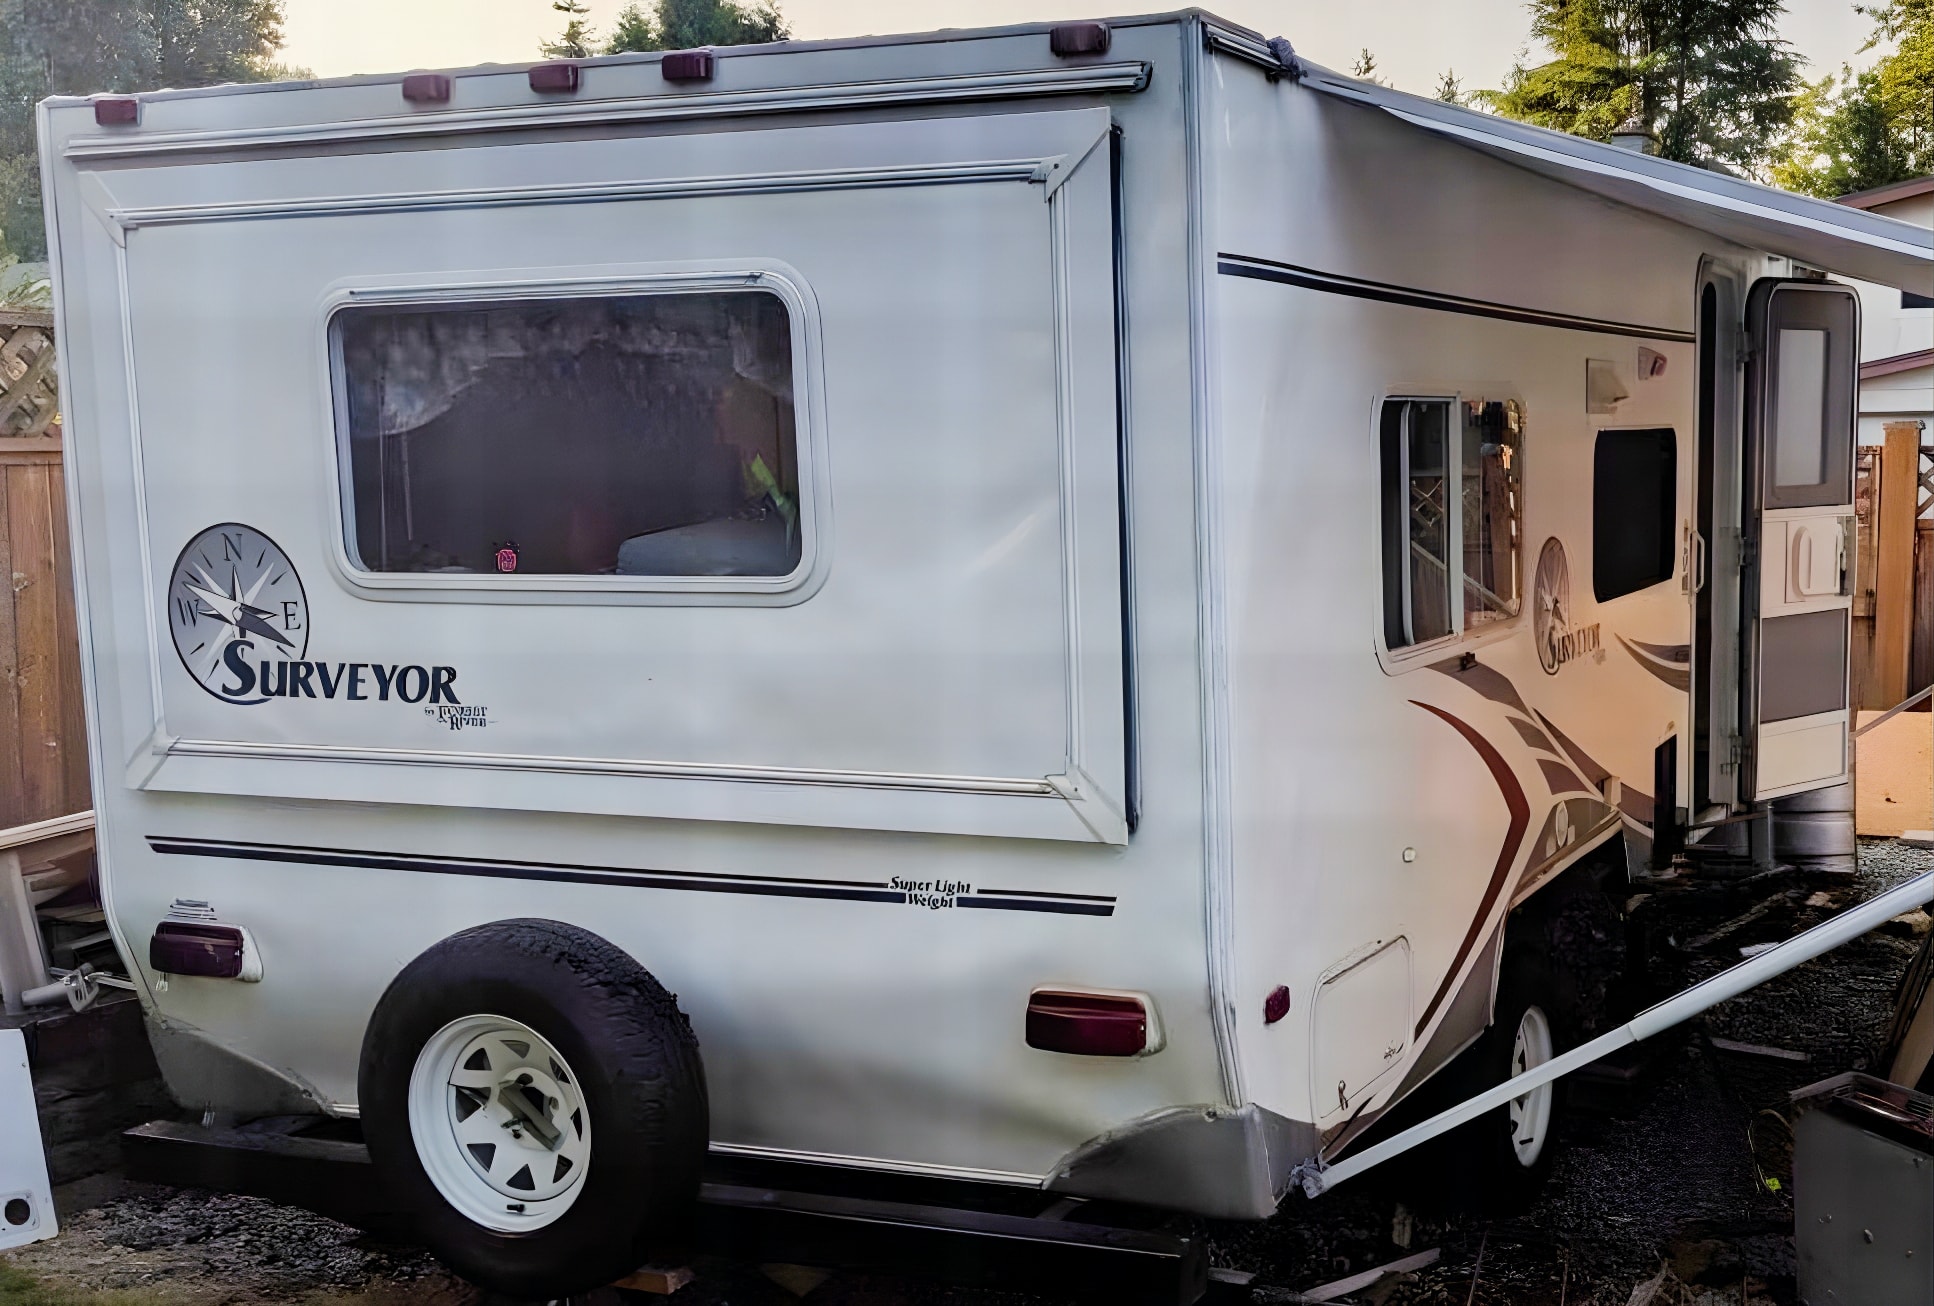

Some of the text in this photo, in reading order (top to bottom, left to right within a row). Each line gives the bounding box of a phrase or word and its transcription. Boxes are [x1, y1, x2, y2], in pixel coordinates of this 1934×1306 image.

[221, 532, 243, 561] N
[177, 597, 200, 626] W
[280, 601, 301, 630] E
[221, 640, 461, 704] SURVEYOR
[889, 876, 971, 896] Super Light
[908, 893, 953, 910] Weight
